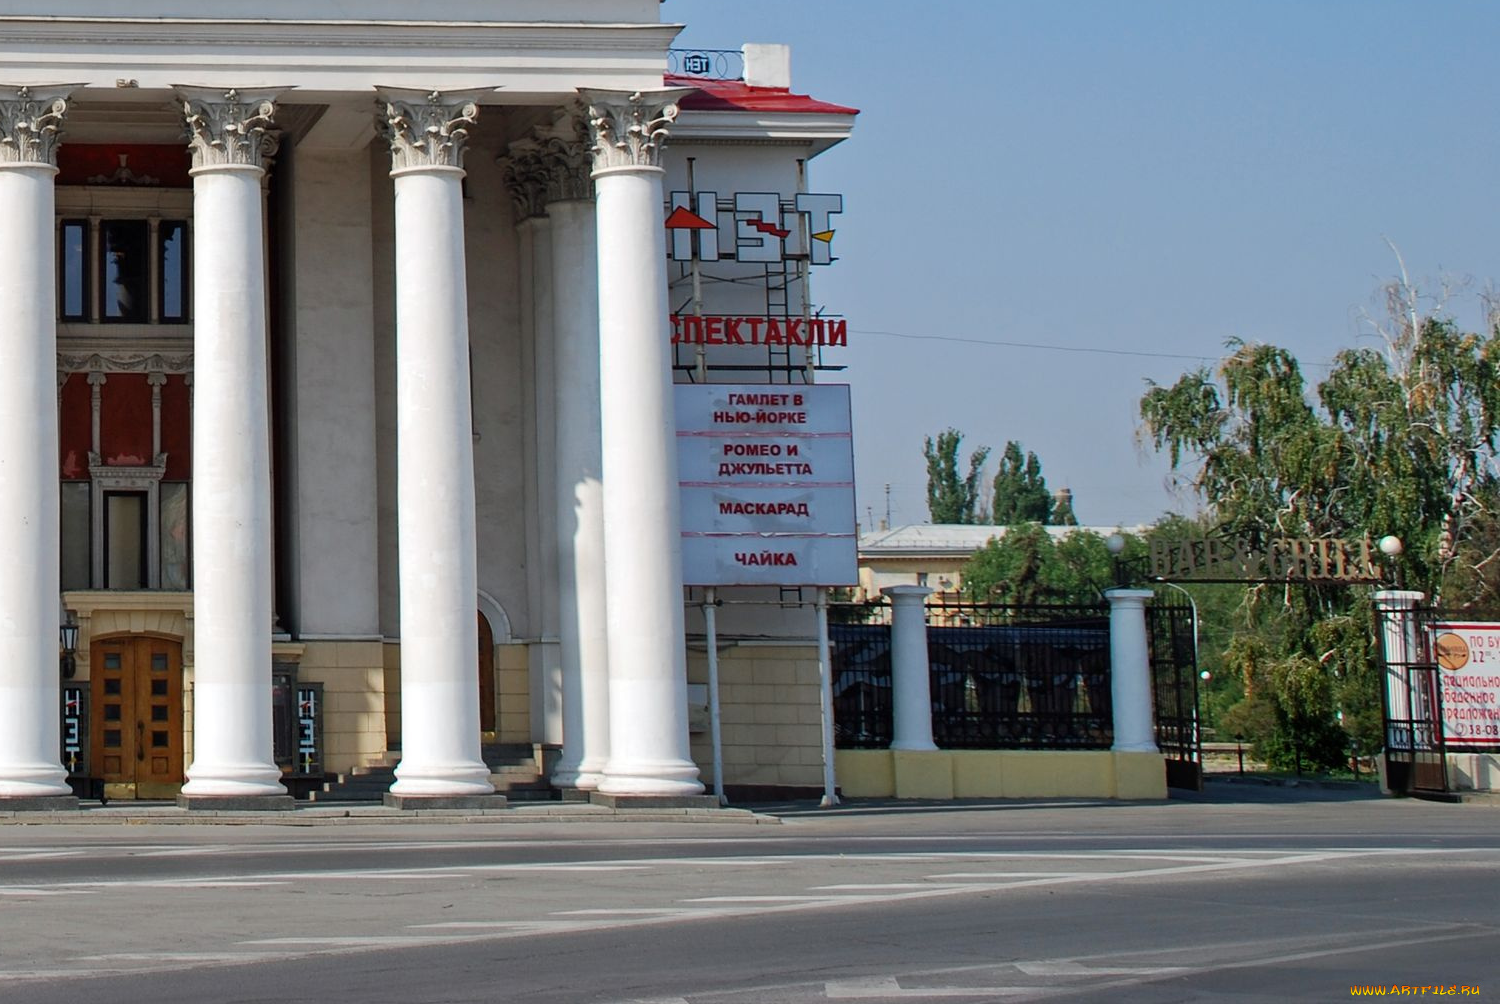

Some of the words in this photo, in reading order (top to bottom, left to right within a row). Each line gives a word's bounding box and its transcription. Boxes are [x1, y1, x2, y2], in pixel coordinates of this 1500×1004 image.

[686, 58, 708, 71] НЭТ
[669, 314, 847, 347] СПЕКТАКЛИ
[728, 393, 789, 406] ГАМЛЕТ
[793, 394, 804, 406] В
[713, 408, 807, 424] НЬЮ-ЙОРКЕ
[723, 444, 781, 456] РОМЕО
[787, 444, 798, 456] И
[718, 463, 813, 476] ДЖУЛЬЕТТА
[719, 503, 809, 517] МАСКАРАД
[734, 550, 798, 566] ЧАЙКА
